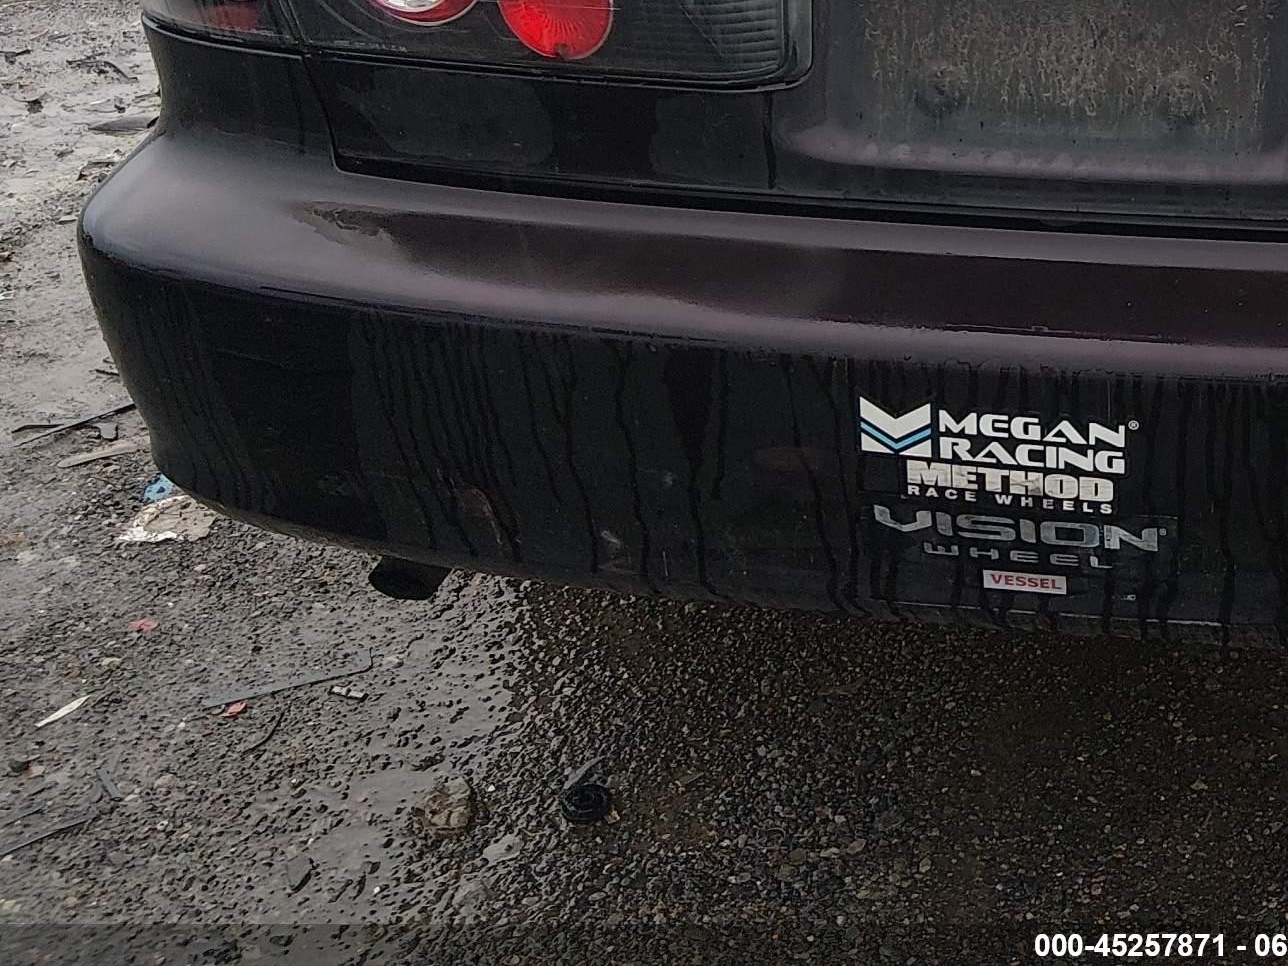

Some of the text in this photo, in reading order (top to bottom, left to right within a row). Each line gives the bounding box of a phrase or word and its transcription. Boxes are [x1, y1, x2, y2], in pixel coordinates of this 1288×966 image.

[938, 436, 1126, 475] RACING
[906, 459, 1115, 503] METHOD
[907, 485, 1114, 515] RACE WHEELS
[873, 504, 1161, 553] VISION
[989, 573, 1064, 591] VESSEL
